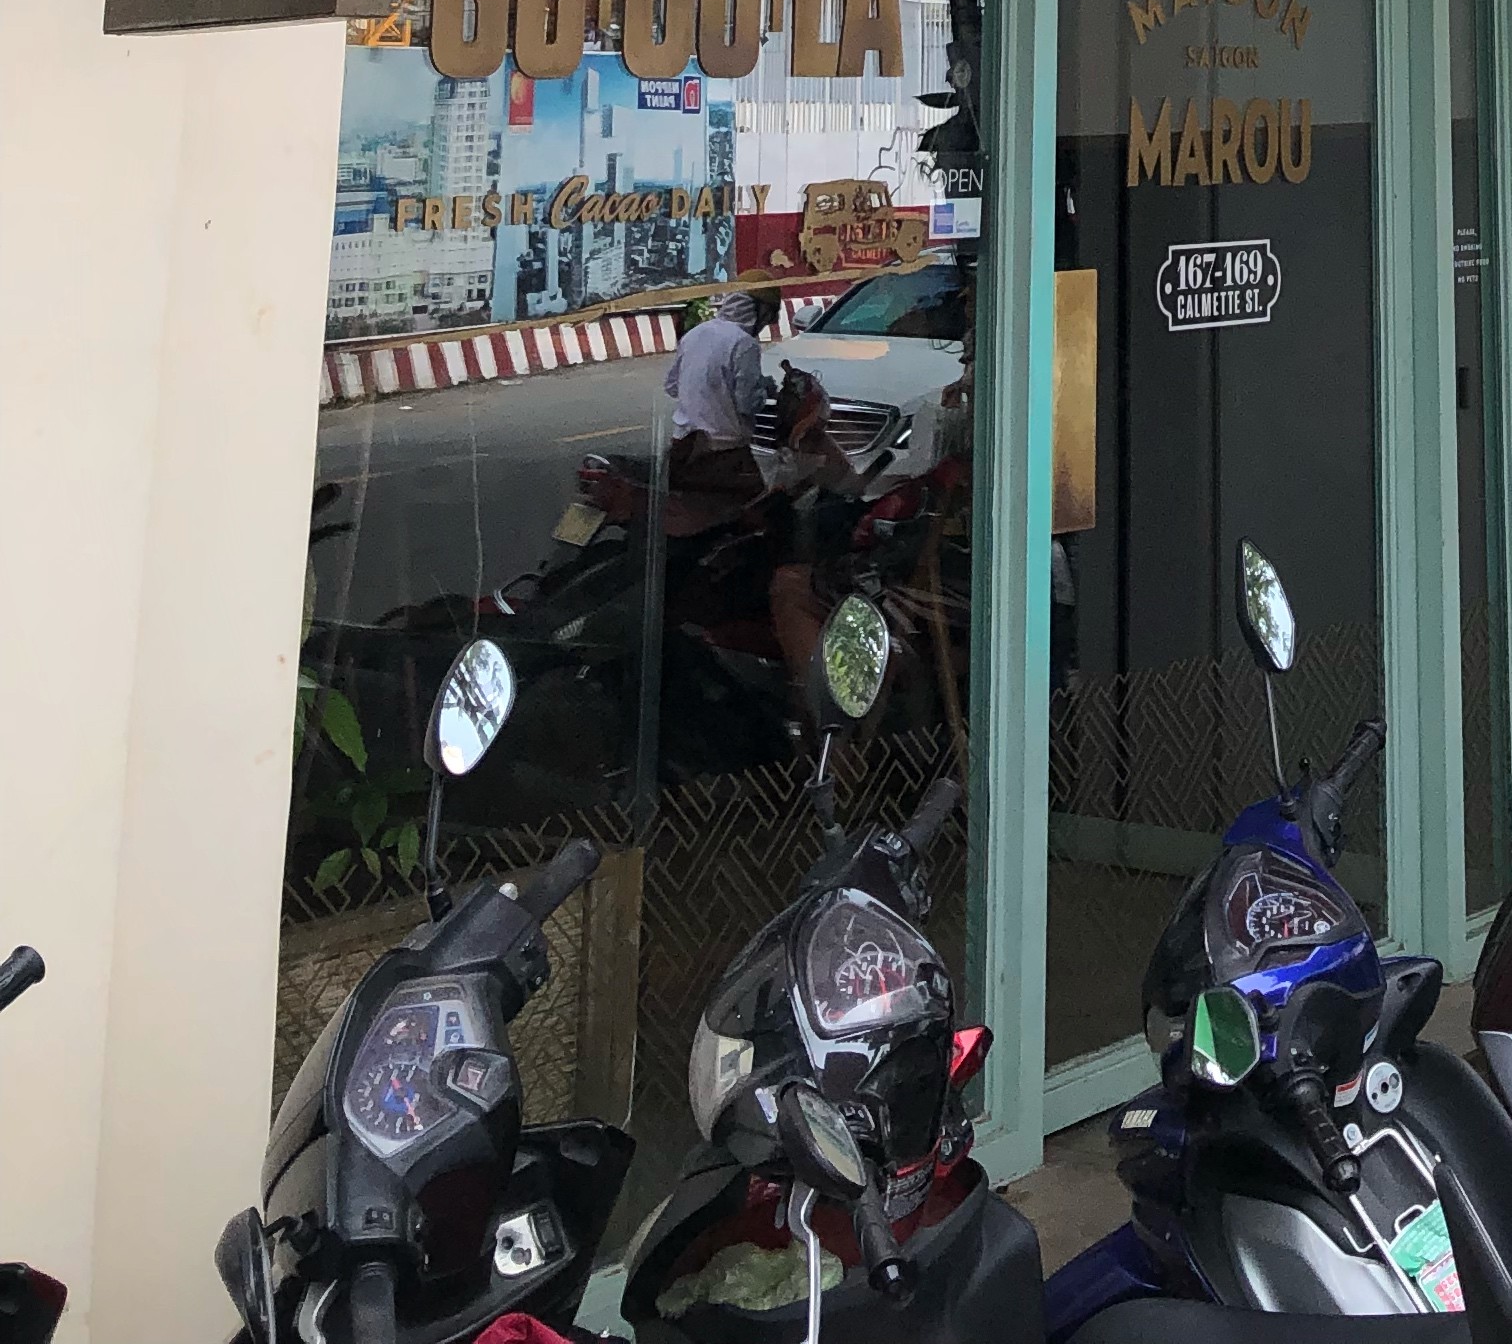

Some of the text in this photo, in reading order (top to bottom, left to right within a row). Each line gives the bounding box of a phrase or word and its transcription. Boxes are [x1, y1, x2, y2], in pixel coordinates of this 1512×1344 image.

[1127, 96, 1312, 187] MAROU
[930, 168, 984, 192] OPEN
[396, 175, 772, 233] FRESH Cacao DAILY
[1177, 250, 1263, 290] 167-169
[1177, 289, 1263, 320] CALMETTE ST.
